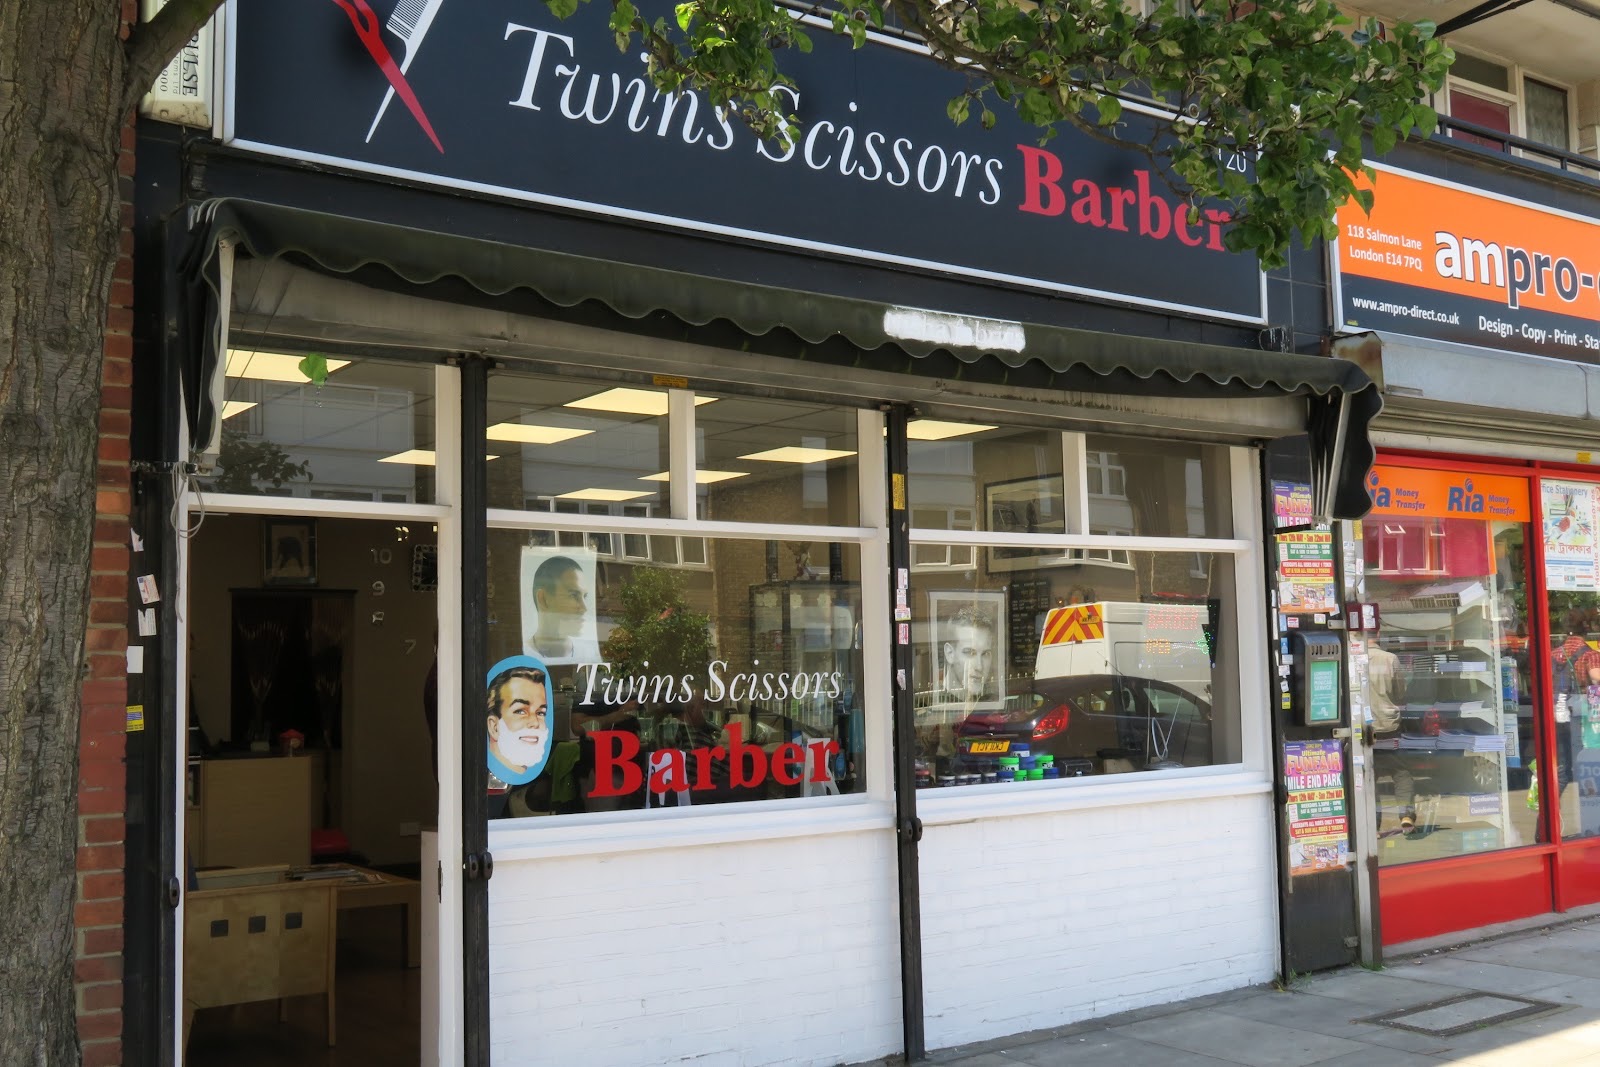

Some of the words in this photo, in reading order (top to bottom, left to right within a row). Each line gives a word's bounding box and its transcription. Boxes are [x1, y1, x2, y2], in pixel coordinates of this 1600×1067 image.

[504, 22, 738, 150] Twins
[756, 84, 1003, 205] Scissors
[1016, 143, 1232, 252] Barber
[1347, 224, 1364, 239] 118
[1366, 228, 1400, 246] Salmon
[1401, 234, 1422, 250] Lane
[1349, 245, 1384, 263] London
[1386, 252, 1402, 266] E14
[1404, 255, 1423, 272] 7PQ
[1434, 230, 1600, 310] ampro-
[1352, 296, 1460, 325] www.ampro-direct.co.uk
[1478, 315, 1513, 339] Design
[1521, 323, 1546, 345] Copy
[1554, 328, 1578, 347] Print
[1584, 333, 1600, 350] Sta
[1395, 487, 1419, 500] Money
[1395, 499, 1426, 512] Transfer
[1447, 477, 1485, 513] Ria
[1488, 494, 1510, 509] Money
[1488, 506, 1516, 517] Transfer
[371, 580, 385, 596] 9
[1145, 638, 1171, 654] OPEN
[575, 660, 695, 707] Twins
[704, 659, 842, 703] Scissors
[586, 721, 840, 799] Barber
[1286, 751, 1341, 775] FUNFAIR
[1301, 749, 1326, 757] Ultimate
[1287, 775, 1305, 790] MILE
[1307, 774, 1321, 789] END
[1323, 772, 1342, 787] PARK
